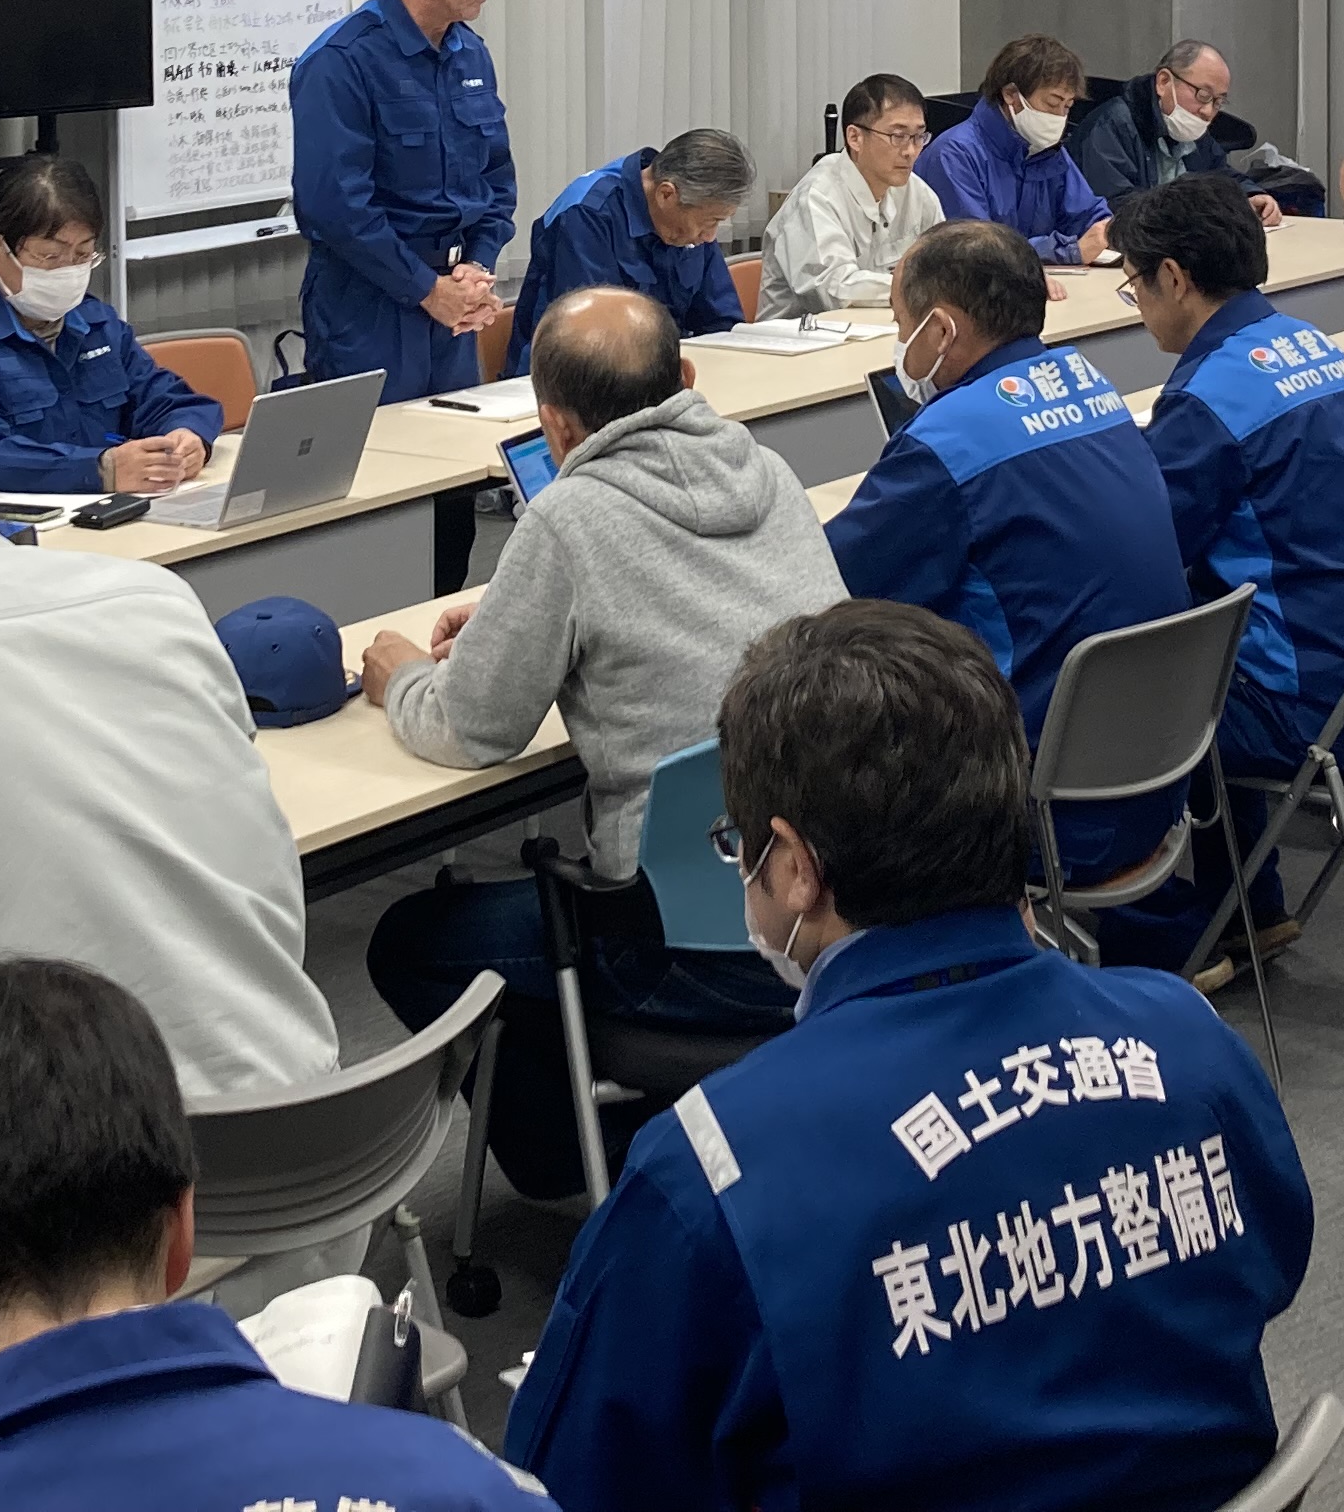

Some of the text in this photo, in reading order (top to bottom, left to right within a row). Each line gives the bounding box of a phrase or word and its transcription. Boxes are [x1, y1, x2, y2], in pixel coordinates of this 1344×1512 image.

[1270, 329, 1337, 367] 能登
[1027, 352, 1108, 402] 能登
[1274, 369, 1323, 398] NOTO
[1021, 391, 1125, 436] NOTO TOWN
[891, 1036, 1166, 1181] 国土交通省
[872, 1134, 1244, 1359] 東北地方整備局
